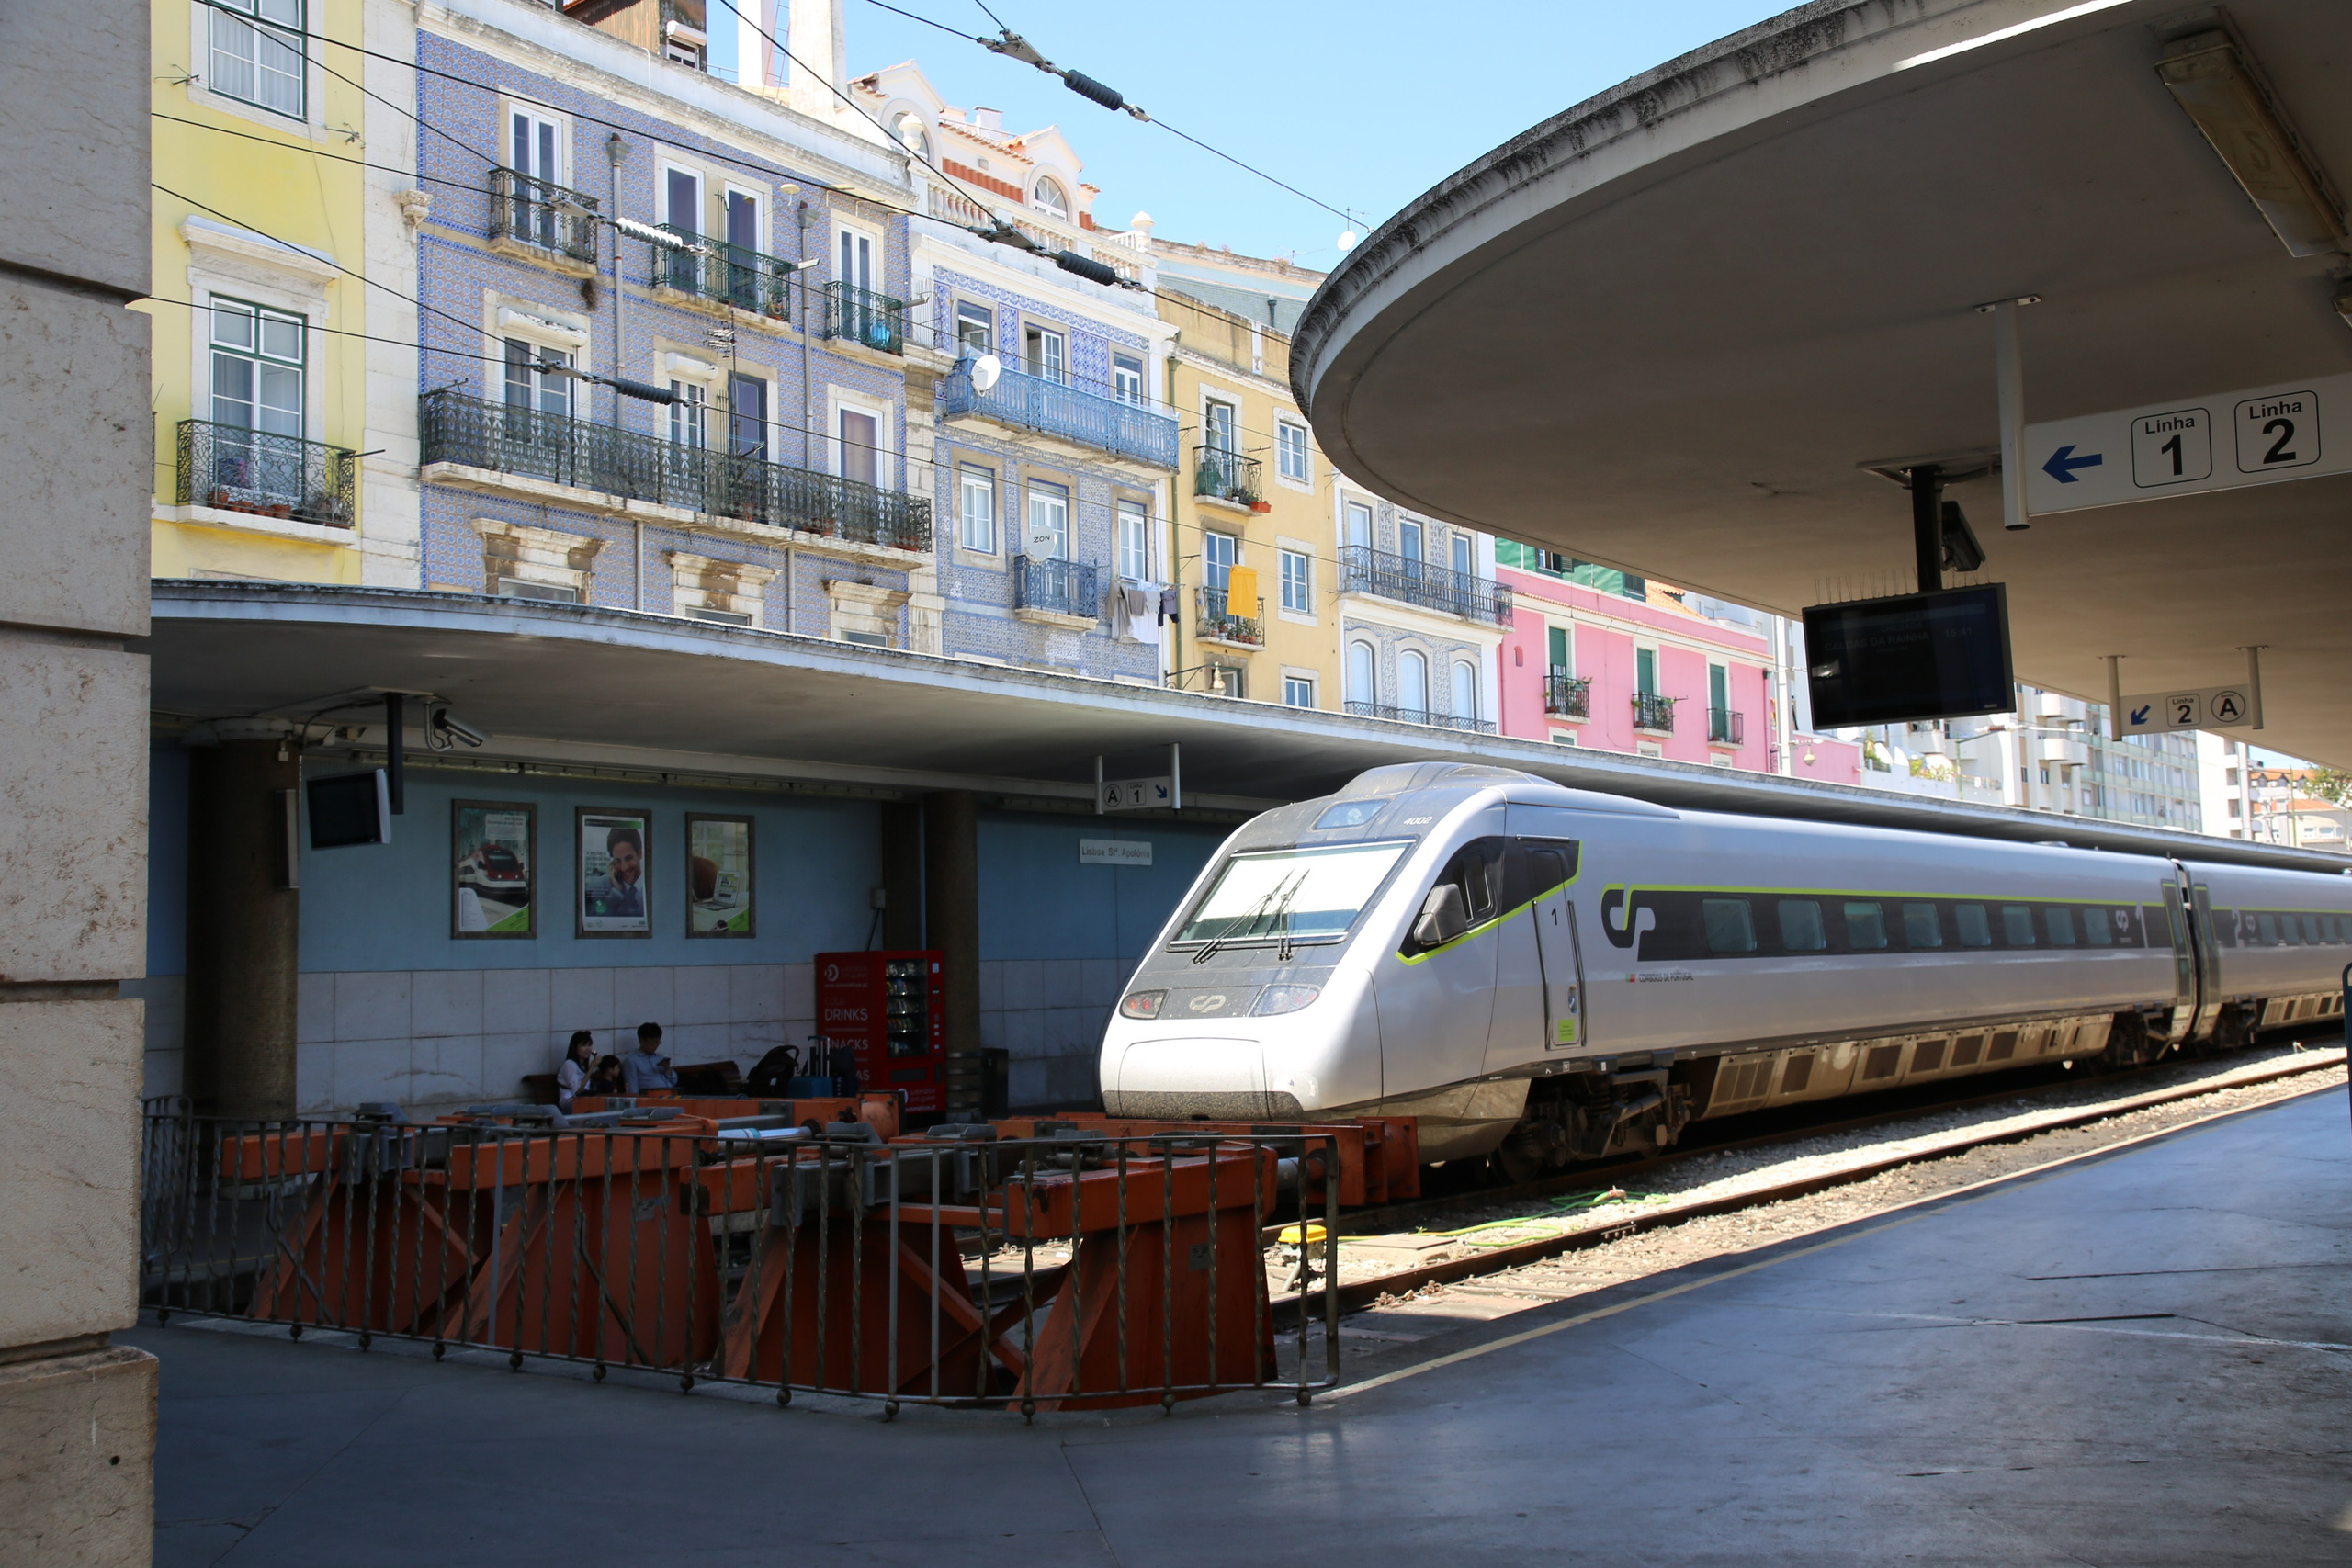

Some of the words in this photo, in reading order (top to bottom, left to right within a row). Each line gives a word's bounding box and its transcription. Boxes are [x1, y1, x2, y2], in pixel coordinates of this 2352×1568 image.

[2249, 401, 2302, 420] Linha
[2144, 417, 2195, 434] Linha
[2262, 418, 2297, 465] 2
[2161, 434, 2183, 476] 1
[1033, 535, 1050, 543] ZON
[1880, 621, 1925, 633] CHEGADA
[1824, 638, 1868, 652] CALDAS
[1870, 637, 1885, 647] DA
[1888, 632, 1930, 646] RAINHA
[2172, 697, 2195, 705] Linha
[2177, 705, 2192, 724] 2
[2219, 697, 2238, 717] A
[1108, 789, 1118, 804] A
[1134, 789, 1140, 803] 1
[1403, 816, 1433, 826] 4002
[1081, 846, 1105, 857] Lisboa
[1551, 908, 1558, 926] 1
[2135, 902, 2148, 948] 1
[2232, 906, 2245, 947] 2
[1639, 974, 1663, 983] COMBOIOS
[1664, 974, 1669, 982] DE
[1670, 972, 1694, 981] PORTUGAL
[824, 1008, 868, 1021] DRINKS
